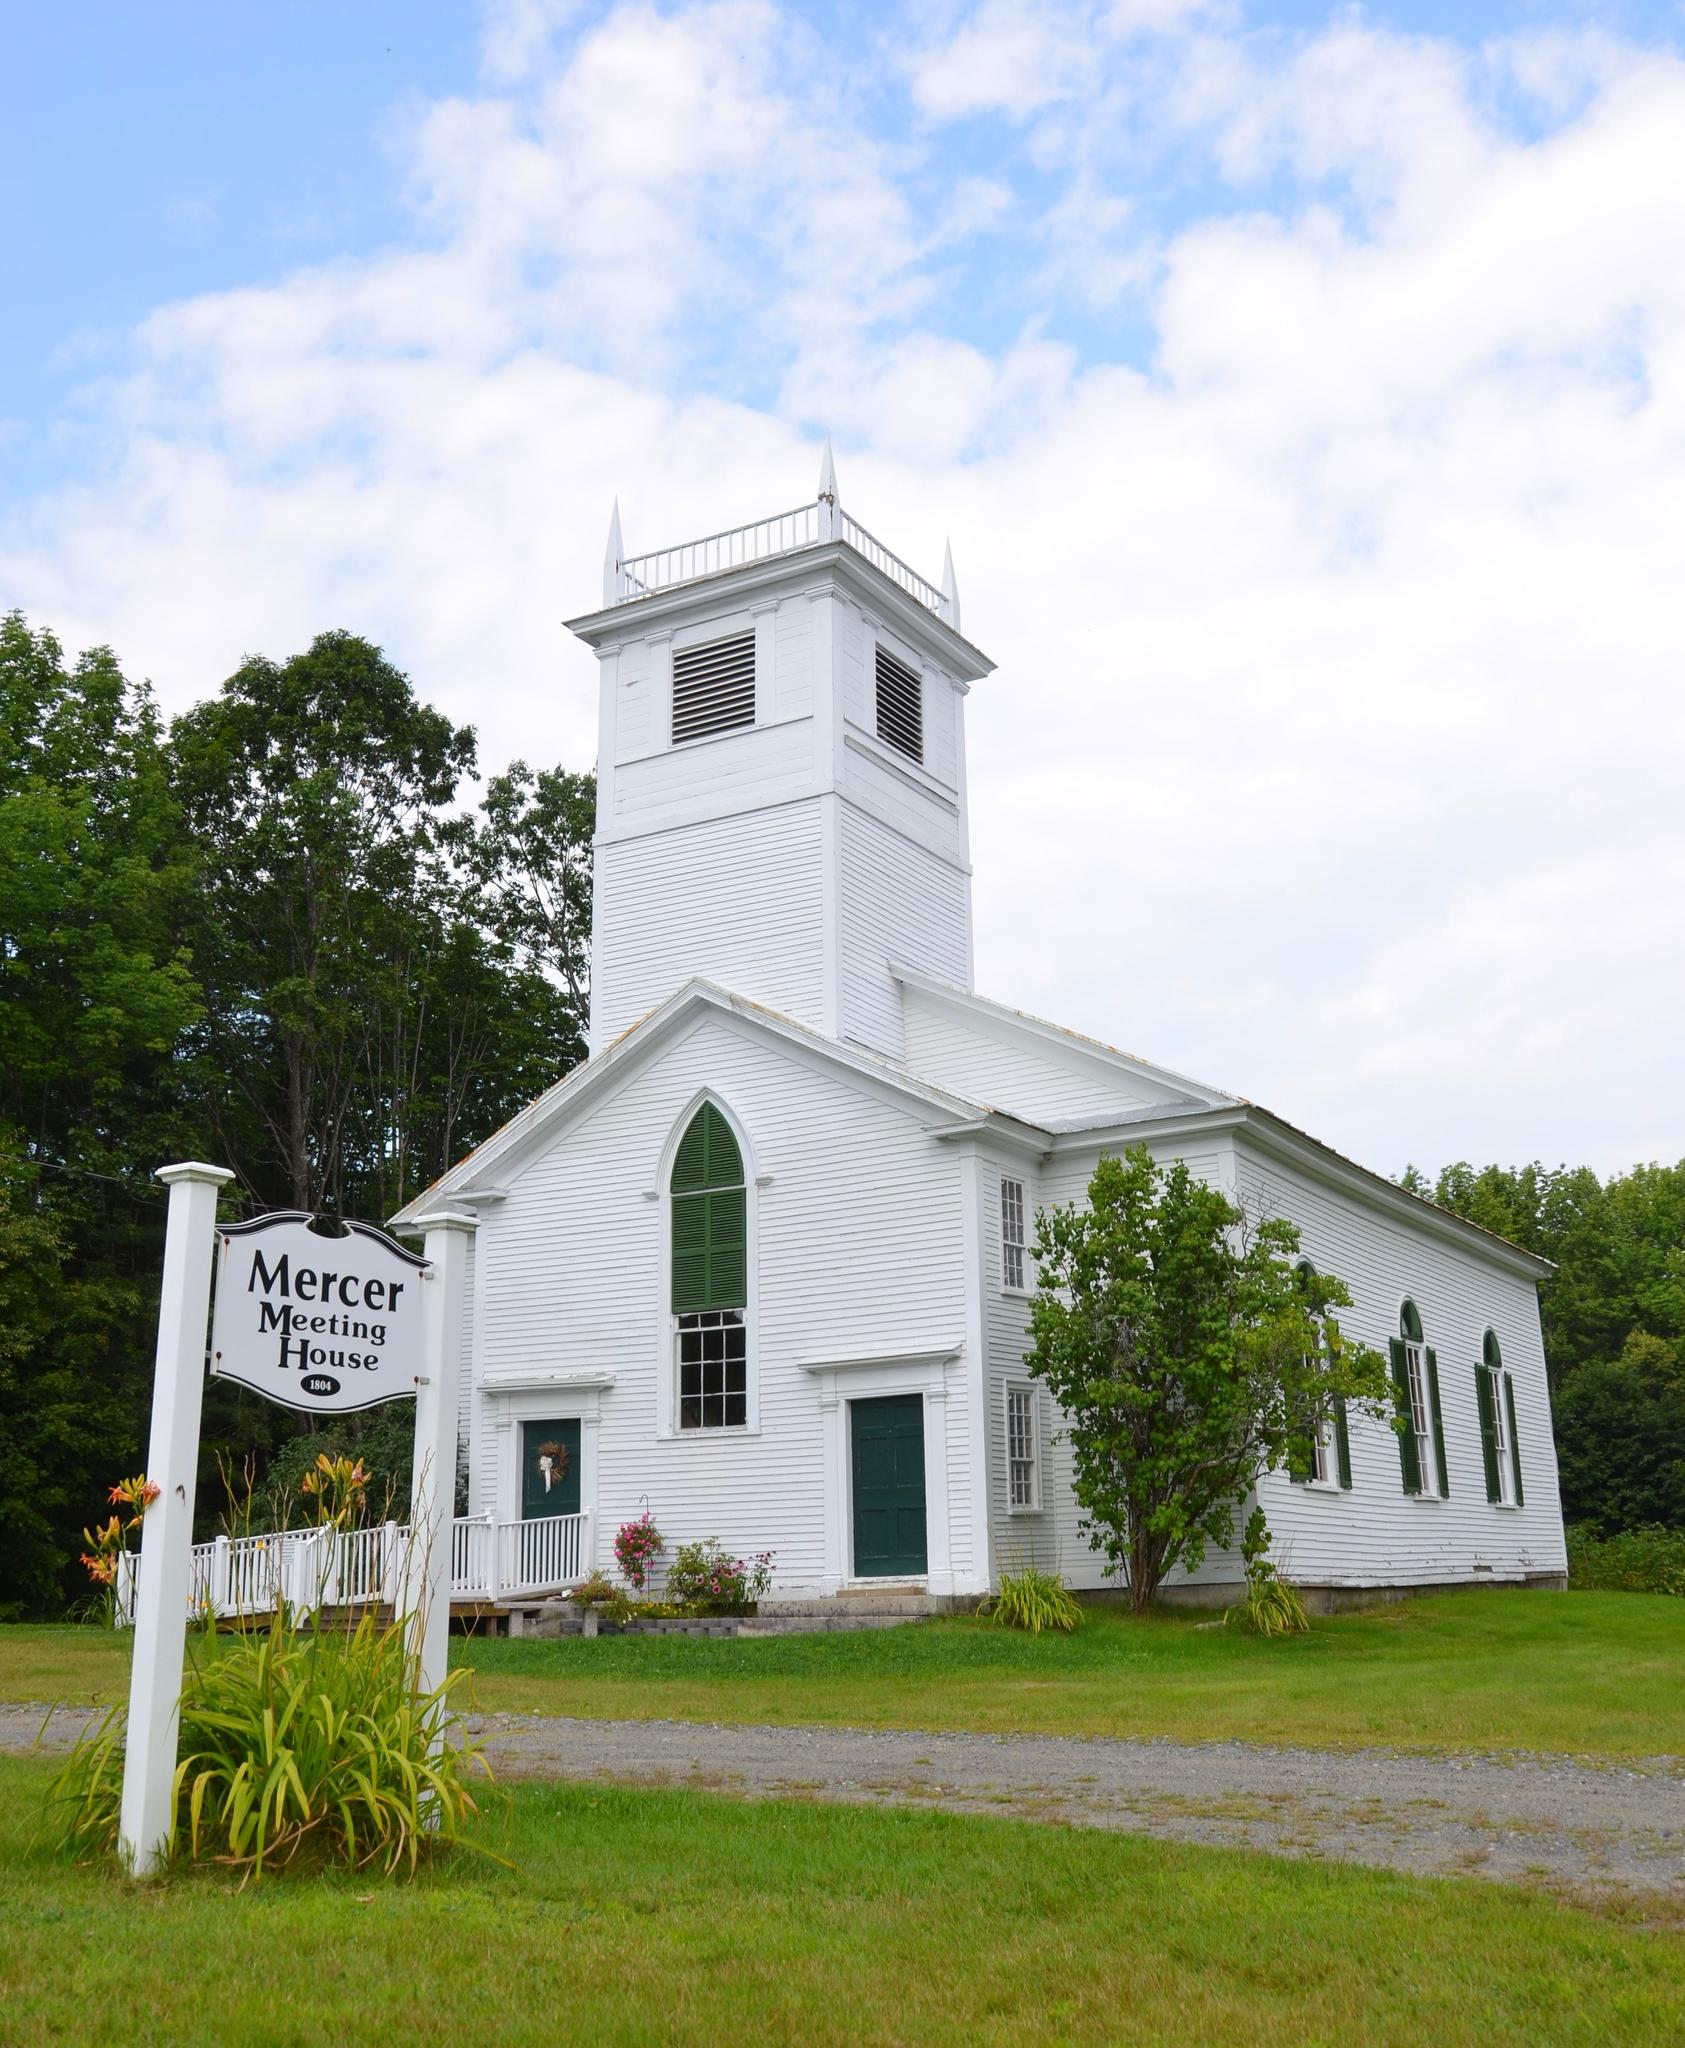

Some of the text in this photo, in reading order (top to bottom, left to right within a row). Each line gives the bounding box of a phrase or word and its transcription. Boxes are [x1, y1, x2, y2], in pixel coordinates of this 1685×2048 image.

[248, 1249, 404, 1312] Mercer
[258, 1301, 387, 1346] Meeting
[278, 1336, 379, 1371] House
[310, 1380, 332, 1391] 1804
